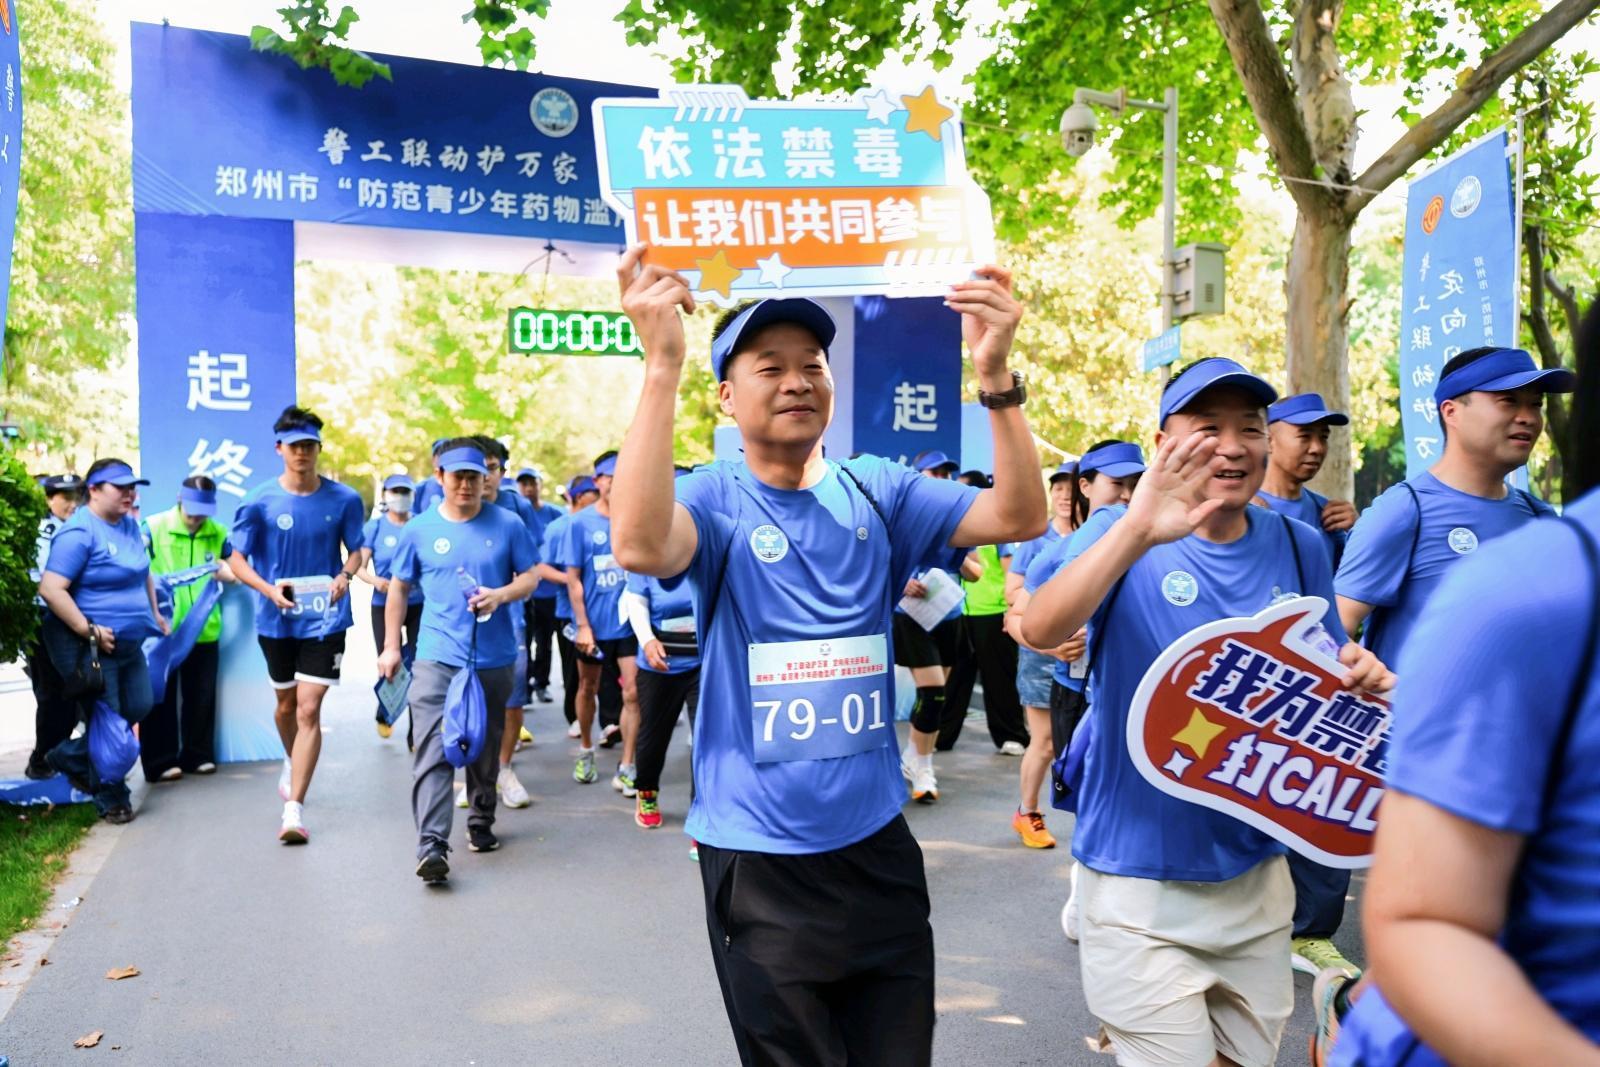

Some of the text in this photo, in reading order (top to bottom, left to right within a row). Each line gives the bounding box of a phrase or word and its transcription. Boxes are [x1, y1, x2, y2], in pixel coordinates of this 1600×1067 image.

[318, 127, 578, 184] 警工联动护万家
[637, 125, 903, 180] 依法禁毒
[215, 165, 620, 228] 郑州市“防范青少年药物滥
[643, 196, 964, 247] 让我们共同参与
[514, 312, 645, 352] 00:00:0
[753, 690, 885, 741] 79-01
[1207, 734, 1385, 832] 打CALL
